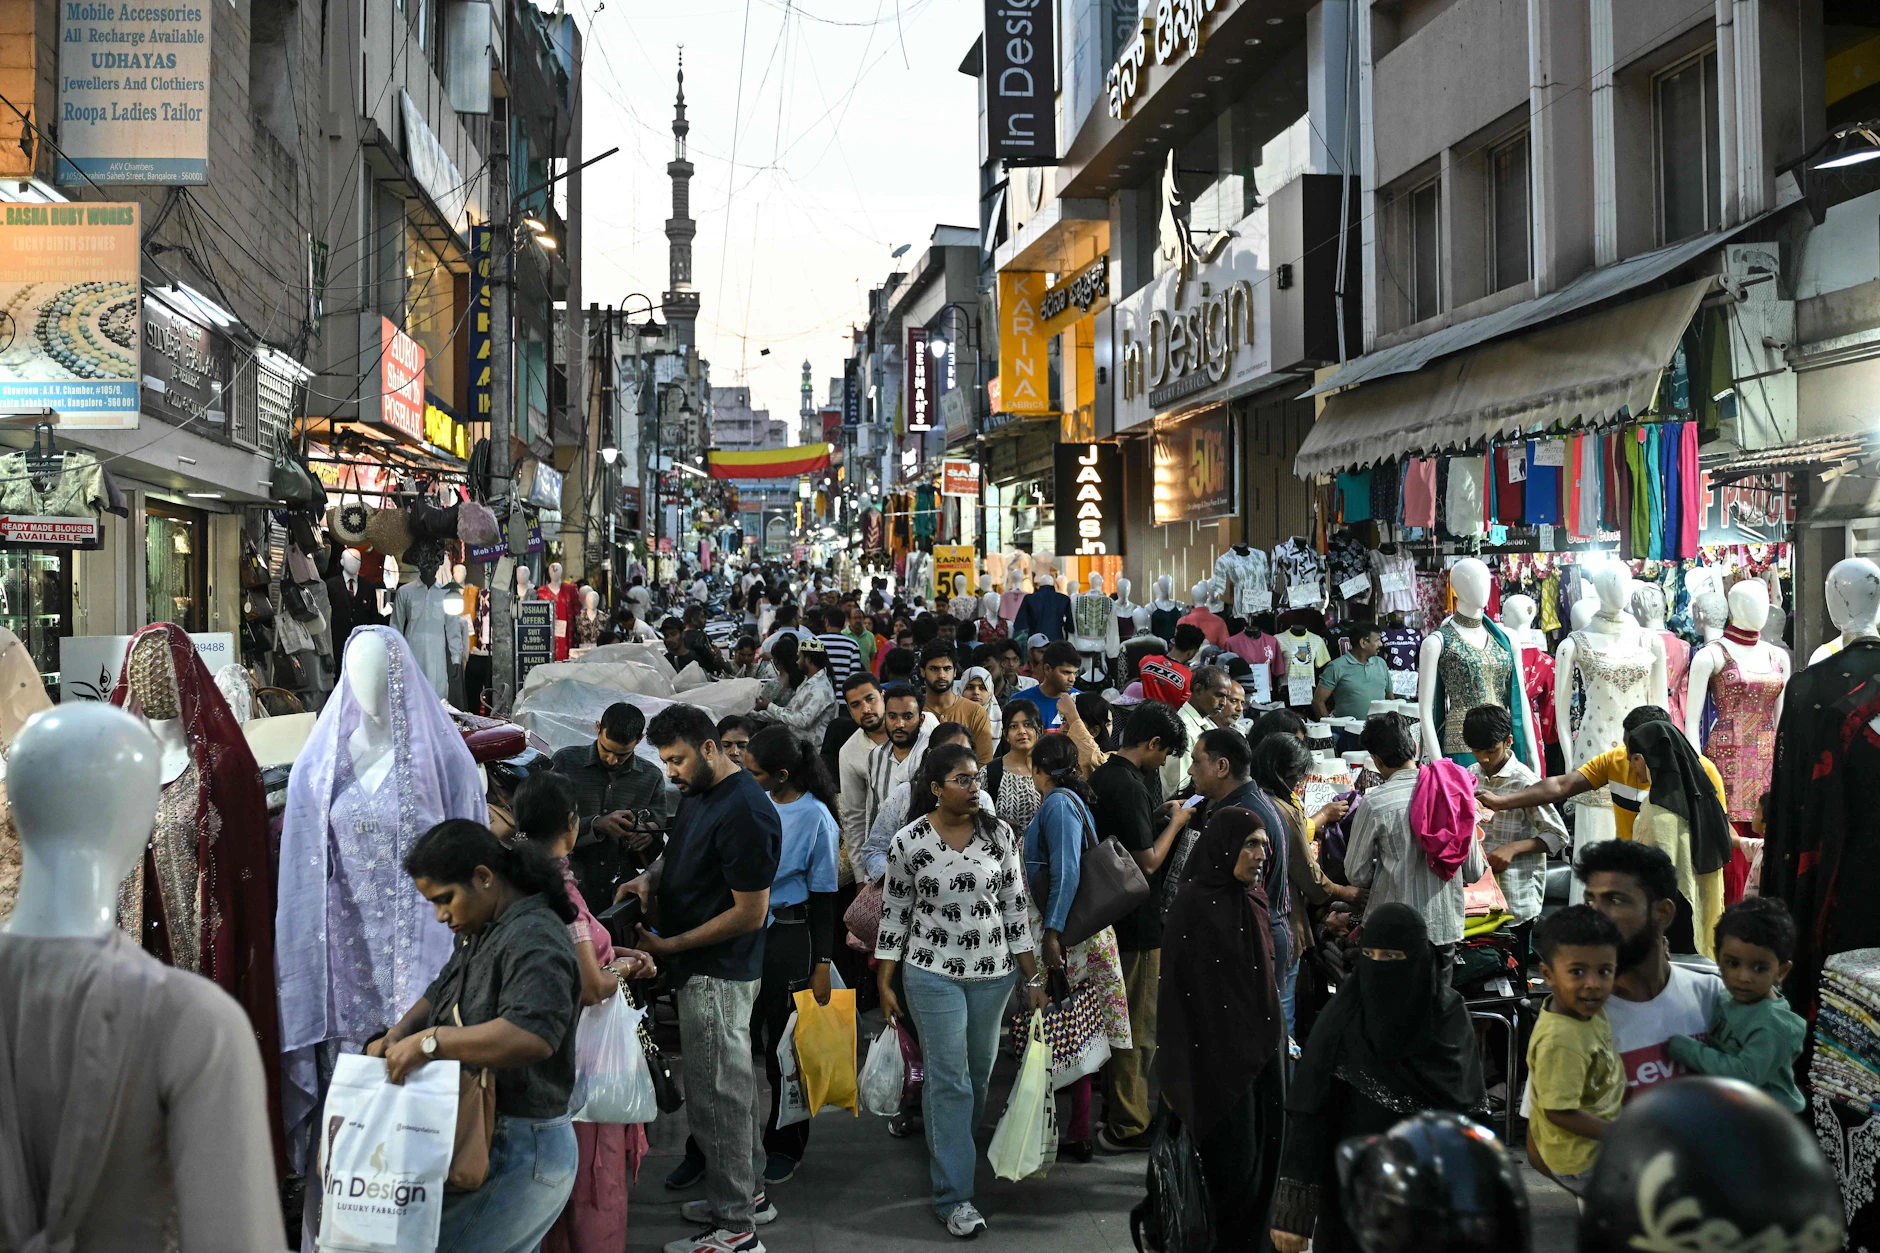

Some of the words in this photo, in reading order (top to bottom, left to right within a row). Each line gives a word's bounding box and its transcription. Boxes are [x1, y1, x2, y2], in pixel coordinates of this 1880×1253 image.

[67, 3, 114, 21] Mobile
[118, 4, 202, 22] Accessories
[64, 28, 82, 43] All
[89, 28, 145, 46] Recharge
[149, 28, 204, 44] Available
[91, 52, 177, 69] UDHAYAS
[63, 77, 120, 93] Jewellers
[123, 77, 147, 90] And
[150, 77, 204, 91] Clothiers
[63, 102, 107, 126] Roopa
[111, 103, 157, 122] Ladies
[161, 103, 203, 122] Tailor
[1000, 113, 1034, 146] In
[110, 162, 123, 171] AKV
[124, 162, 154, 171] Chambers
[84, 172, 105, 180] brahim
[106, 172, 125, 180] Saheb
[126, 172, 146, 181] Street,
[147, 173, 177, 182] Bangalore
[181, 173, 203, 181] 560001
[6, 206, 48, 226] BASHA
[51, 206, 84, 226] RUBY
[87, 206, 134, 226] WORKS
[13, 235, 45, 251] LUCKY
[46, 235, 76, 251] BIRTH
[78, 235, 116, 251] STONES
[1012, 276, 1037, 397] KARINA
[1123, 329, 1144, 402] In
[1148, 280, 1255, 387] Design
[391, 326, 418, 374] AURO
[3, 385, 39, 395] Showroom
[63, 385, 95, 396] Chamber,
[96, 385, 123, 396] #105/9,
[1151, 388, 1175, 406] LUXURY
[1176, 374, 1206, 395] FABRICS
[43, 398, 67, 408] Street,
[68, 398, 103, 409] Bangalore
[107, 398, 121, 408] 560
[122, 398, 135, 408] 001
[1005, 400, 1044, 409] FABRICS
[384, 394, 421, 440] POSHAAK
[1, 522, 28, 531] READY
[30, 523, 53, 532] MADE
[55, 524, 92, 533] BLOUSES
[15, 532, 81, 542] AVAILABLE
[522, 616, 546, 625] OFFERS
[527, 628, 541, 636] SUIT
[522, 643, 546, 651] Onwards
[523, 656, 545, 664] BLAZER
[327, 1174, 343, 1196] In
[349, 1176, 426, 1207] Design
[337, 1202, 370, 1213] LUXURY
[371, 1206, 407, 1216] FABRICS
